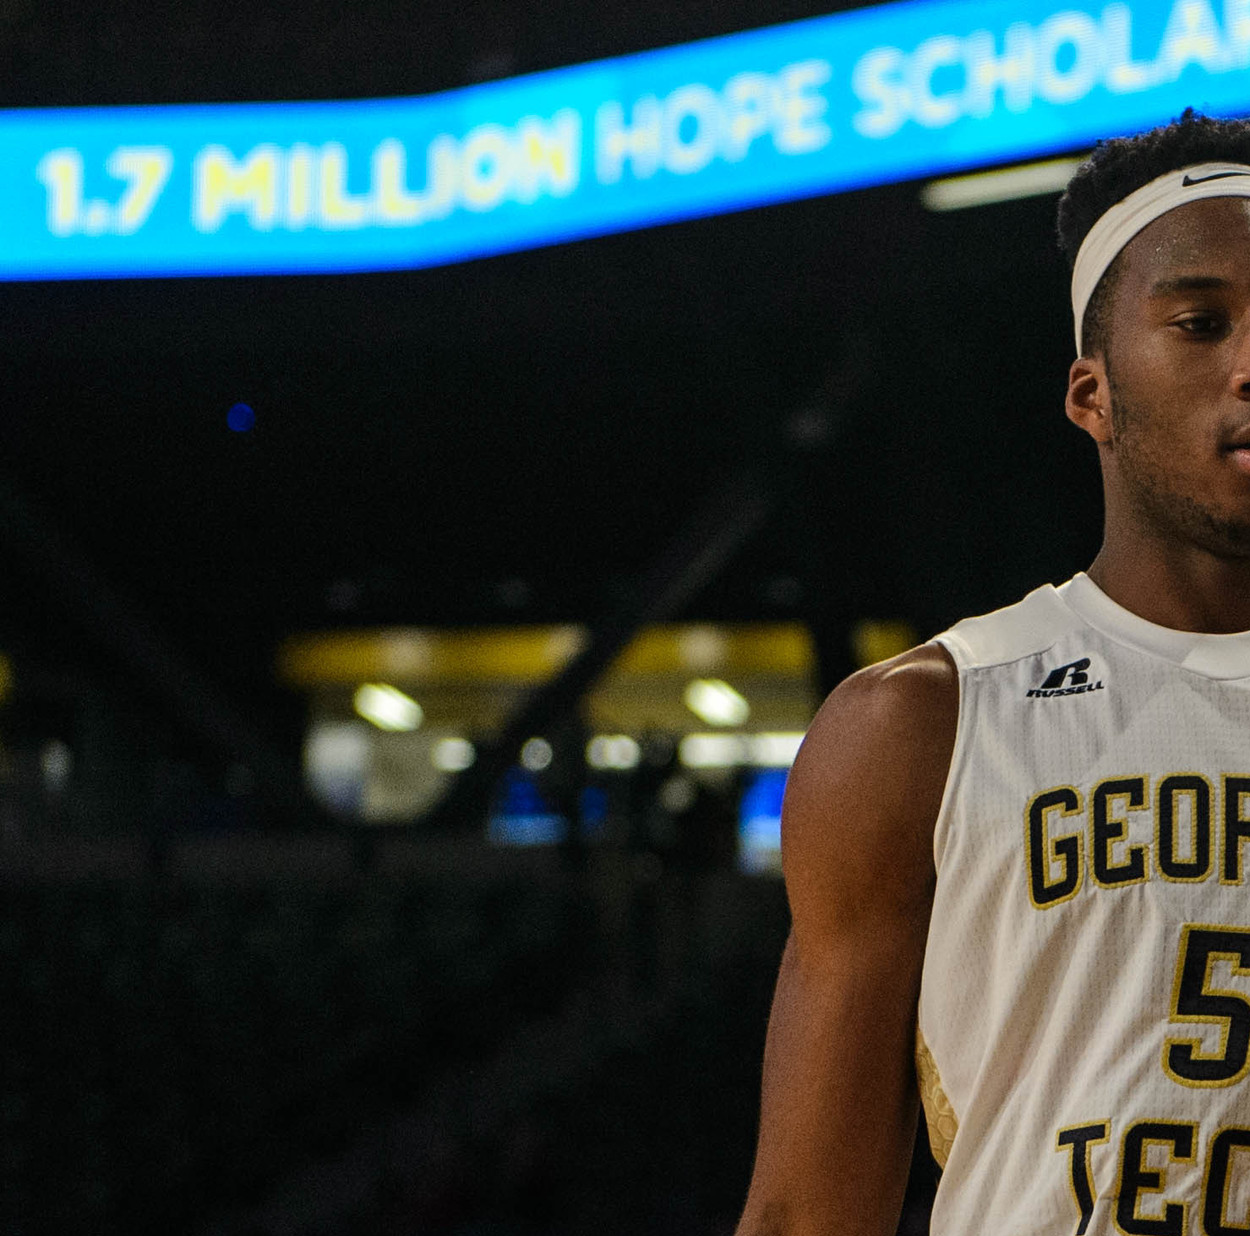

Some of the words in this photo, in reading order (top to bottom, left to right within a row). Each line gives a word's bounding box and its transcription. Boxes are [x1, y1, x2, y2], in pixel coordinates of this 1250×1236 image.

[38, 147, 174, 236] 1.7
[193, 108, 582, 232] MILLION
[595, 58, 832, 186] HOPE
[1026, 680, 1104, 698] RUSSELL
